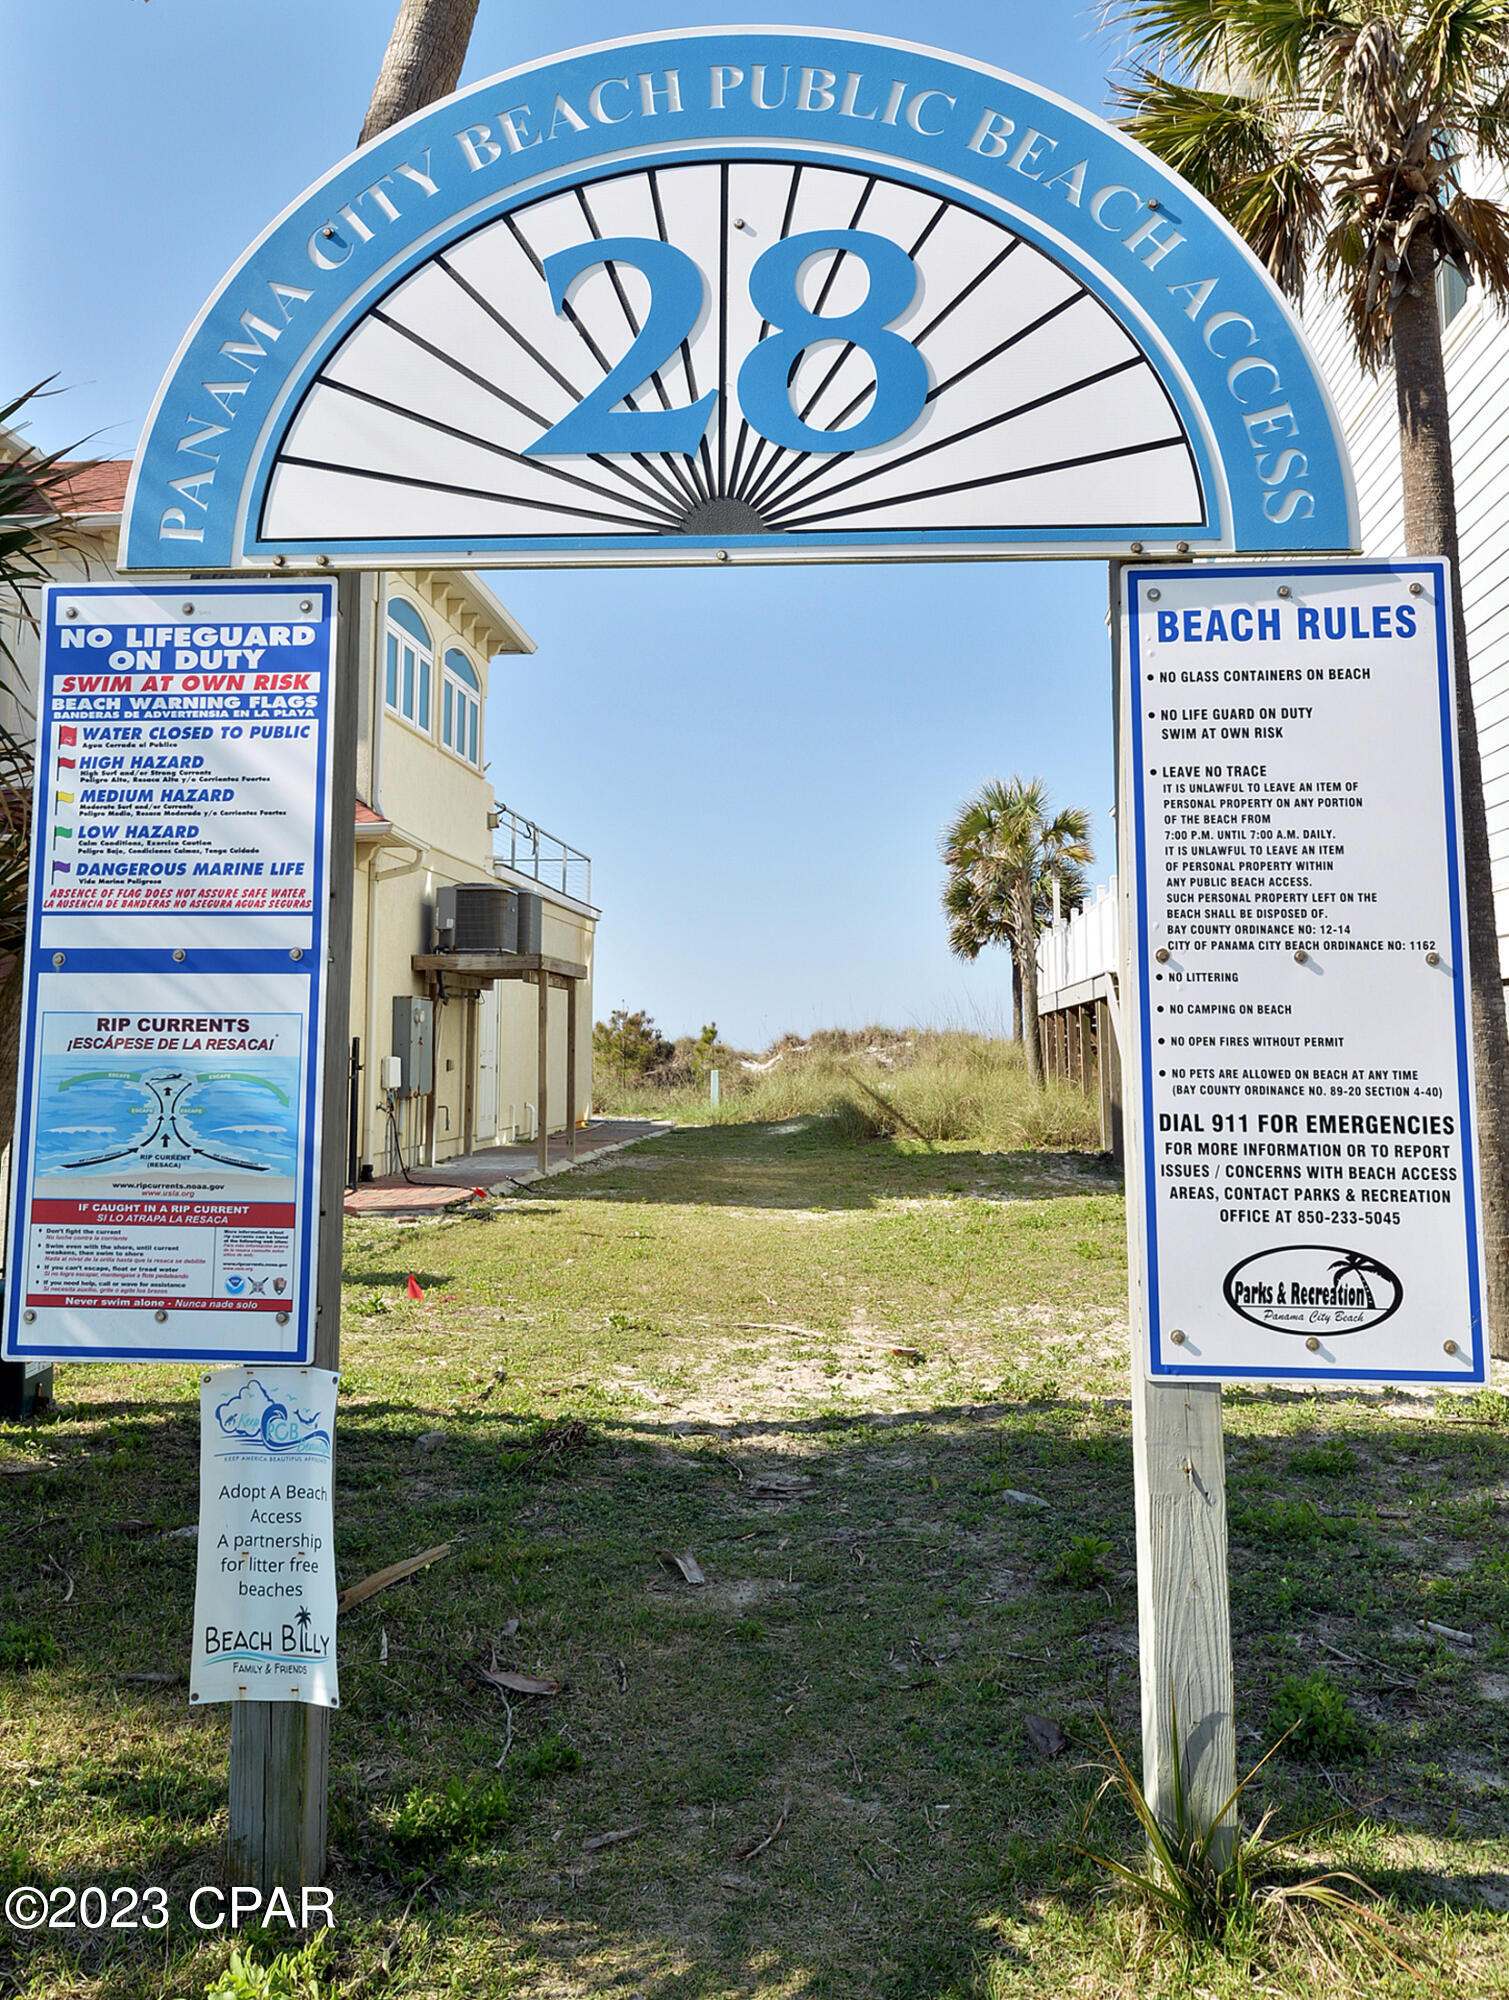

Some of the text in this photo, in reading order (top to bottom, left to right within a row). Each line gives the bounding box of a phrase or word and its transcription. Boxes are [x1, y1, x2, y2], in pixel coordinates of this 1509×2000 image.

[159, 63, 1315, 543] PANAMA CITY BEACH PUBLIC BEACH ACCESS
[522, 230, 929, 458] 28
[1158, 605, 1417, 642] BEACH RULES
[61, 626, 315, 648] NO LIFEGUARD
[109, 649, 265, 670] ON DUTY
[1160, 668, 1370, 683] NO GLASS CONTAINERS ON BEACH
[61, 674, 311, 692] SWIM AT OWN RISK
[52, 695, 318, 711] BEACH WARNING FLAGS
[53, 711, 120, 719] BANDERAS
[144, 710, 229, 718] ADVERTENSIA
[233, 709, 249, 717] EN
[254, 709, 270, 717] LA
[273, 708, 315, 717] PLAYA
[1161, 708, 1312, 720] NO LIFE GUARD ON DUTY
[83, 726, 310, 740] WATER CLOSED TO PUBLIC
[1162, 727, 1283, 739] SWIM AT OWN RISK
[79, 756, 204, 769] HIGH HAZARD
[1163, 766, 1266, 777] LEAVE NO TRACE
[1163, 782, 1358, 793] IT IS UNLAWFUL TO LEAVE AN ITEM OF
[80, 789, 235, 803] MEDIUM HAZARD
[1164, 798, 1362, 808] PERSONAL PROPERTY ON ANY PORTION
[1165, 815, 1270, 824] OF THE BEACH FROM
[78, 825, 199, 838] LOW HAZARD
[1165, 830, 1335, 840] 7:00 P.M. UNTIL 7:00 A.M. DAILY.
[76, 863, 304, 875] DANGEROUS MARINE LIFE
[1168, 925, 1350, 934] BAY COUNTY ORDINANCE NO: 12-14
[1169, 972, 1238, 982] NO LITTERING
[1170, 1005, 1291, 1014] NO CAMPING ON BEACH
[97, 1018, 249, 1032] RIP CURRENTS
[67, 1035, 154, 1051] ¡ESCÁPESE
[157, 1038, 179, 1049] DE
[182, 1038, 201, 1050] LA
[1171, 1037, 1343, 1046] NO OPEN FIRES WITHOUT PERMIT
[1160, 1114, 1454, 1134] DIAL 911 FOR EMERGENCIES
[147, 1161, 182, 1169] (RESACA)
[112, 1182, 225, 1191] www.ripcurrents.noaa.gov
[78, 1203, 249, 1215] IF CAUGHT IN A RIP CURRENT
[1220, 1209, 1400, 1224] OFFICE AT 850-233-5045
[1234, 1280, 1365, 1307] Parks & Recreation
[65, 1297, 100, 1306] Never
[101, 1298, 130, 1307] swim
[133, 1298, 165, 1307] alone
[175, 1299, 206, 1309] Nunca
[209, 1299, 234, 1309] nade
[236, 1300, 258, 1309] solo
[1263, 1309, 1365, 1324] Panama City Beach
[266, 1422, 299, 1441] PCB
[219, 1484, 326, 1501] Adopt A Beach
[251, 1509, 301, 1524] Access
[217, 1533, 322, 1552] A partnership
[222, 1557, 318, 1573] for litter free
[239, 1581, 302, 1597] beaches
[205, 1618, 330, 1655] BEACH BILLY
[233, 1662, 307, 1675] FAMILY & FRIENDS
